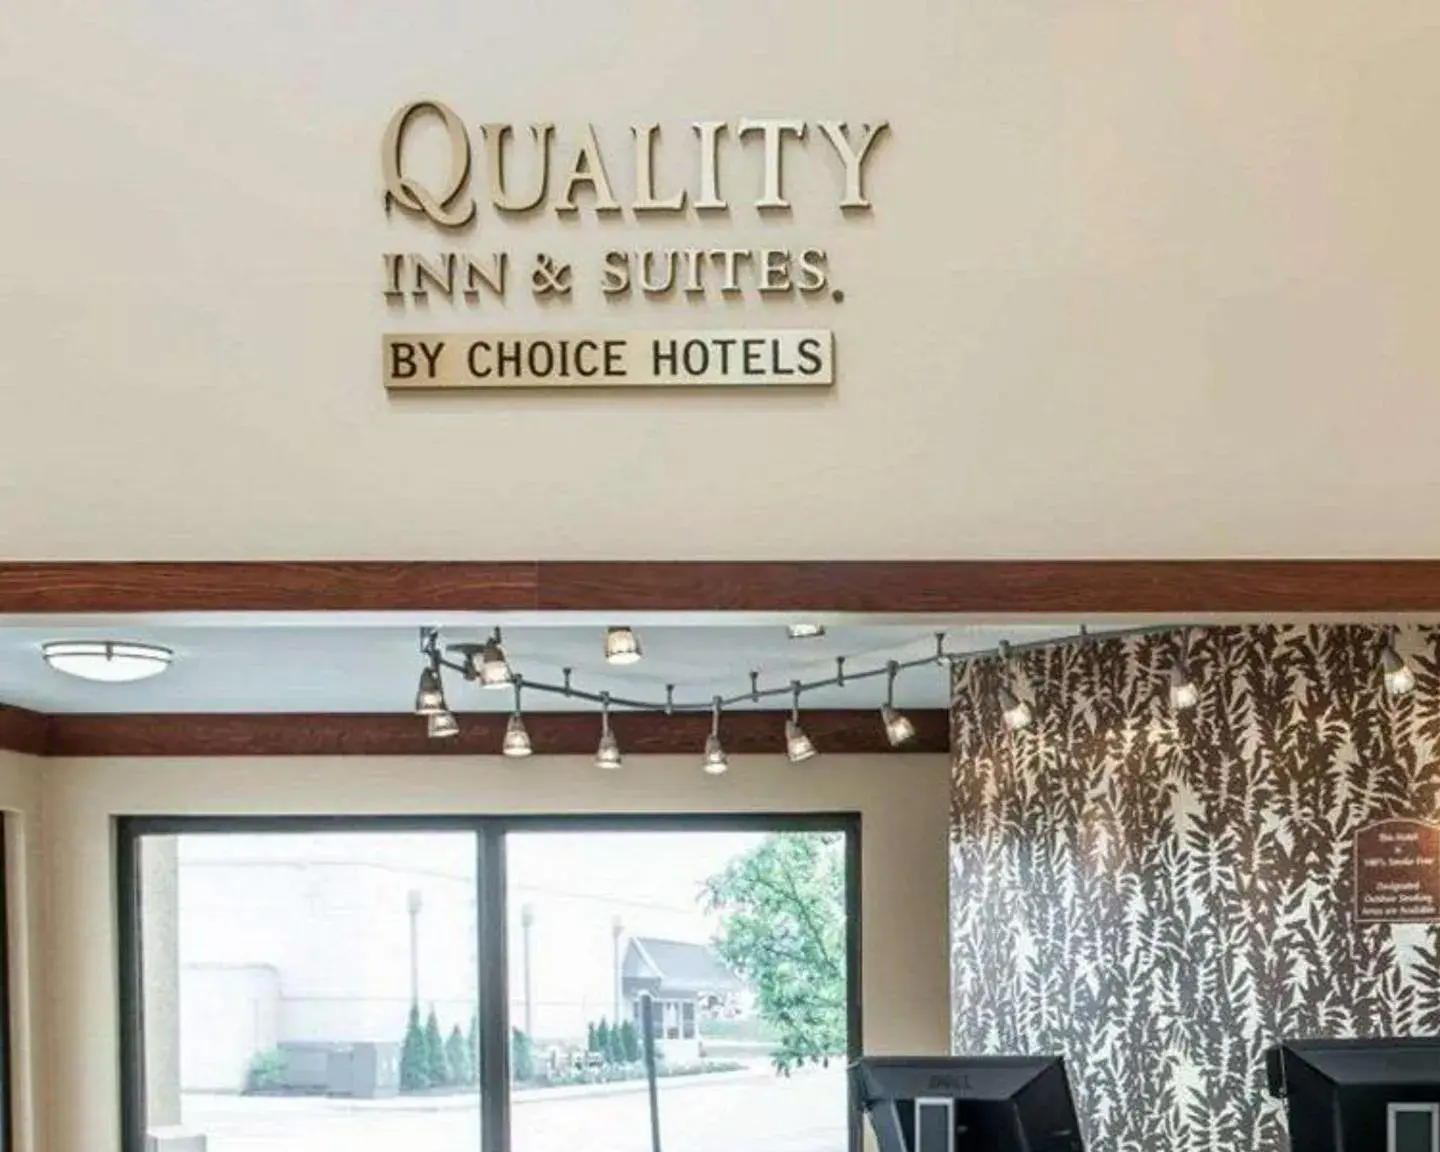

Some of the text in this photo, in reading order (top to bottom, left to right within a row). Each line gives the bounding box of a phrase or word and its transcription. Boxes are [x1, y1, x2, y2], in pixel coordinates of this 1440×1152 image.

[382, 100, 891, 228] QUALITY
[383, 253, 509, 296] INN
[532, 252, 572, 295] &
[390, 338, 824, 379] BY CHOICE HOTELS
